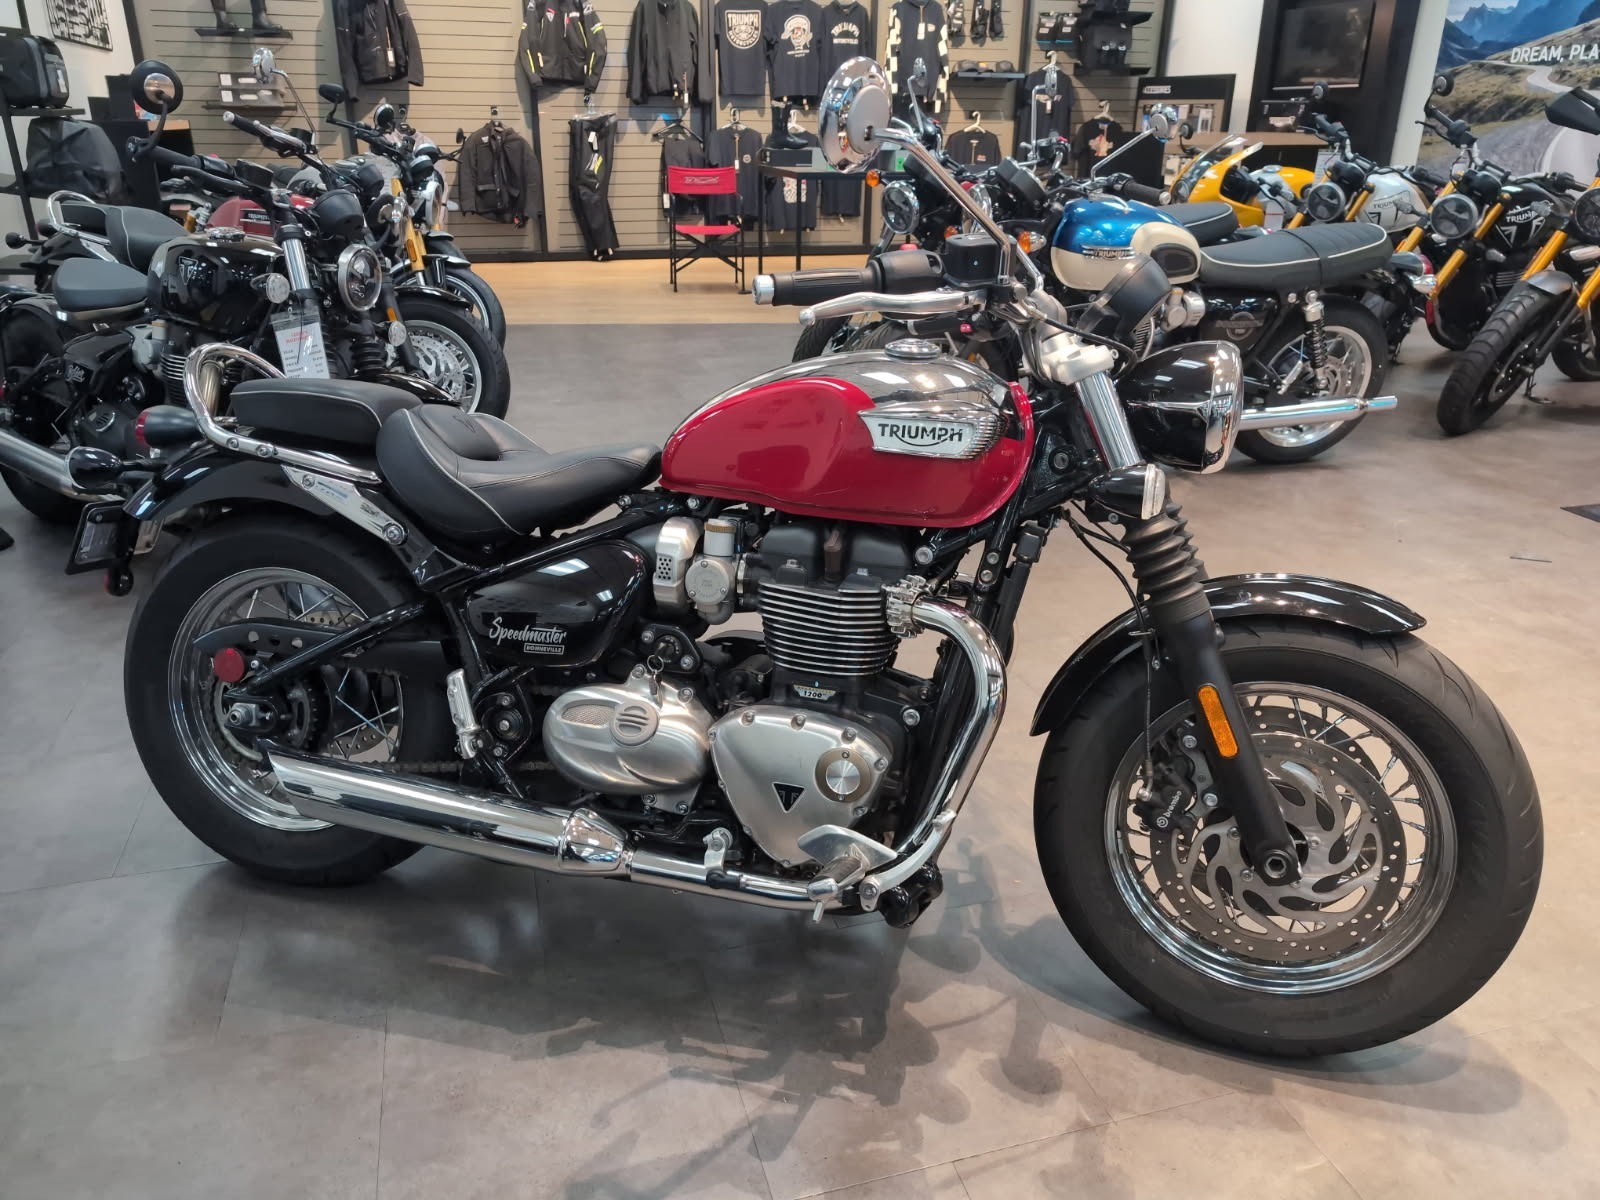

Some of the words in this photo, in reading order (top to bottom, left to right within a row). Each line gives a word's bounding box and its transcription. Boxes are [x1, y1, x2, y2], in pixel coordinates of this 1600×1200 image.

[727, 13, 759, 28] TRIUMPH
[1510, 45, 1565, 63] DREAM,
[1505, 210, 1539, 223] TRIUMP
[878, 423, 963, 447] TRIUMPH
[488, 616, 567, 646] Speedmaster
[526, 645, 562, 653] BONNEVILLE
[804, 690, 823, 698] 1200
[1163, 790, 1182, 818] brembo
